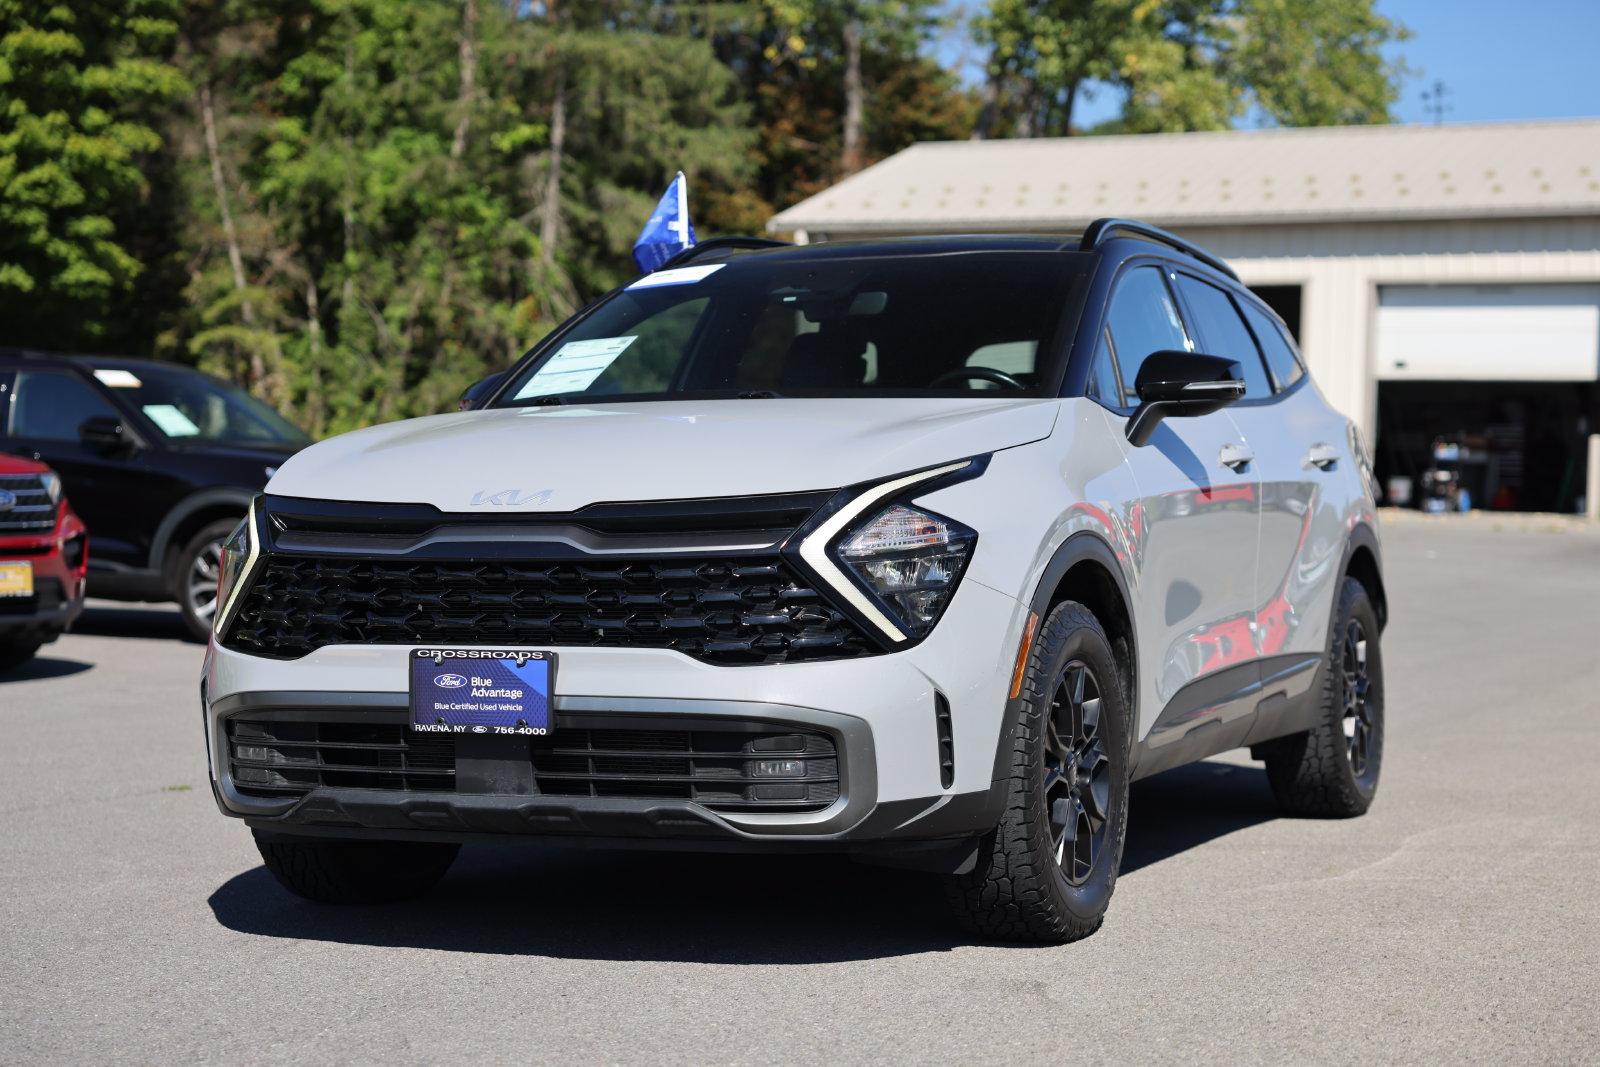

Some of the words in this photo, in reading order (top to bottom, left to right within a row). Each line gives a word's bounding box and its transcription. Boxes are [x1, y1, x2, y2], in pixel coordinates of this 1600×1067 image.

[469, 489, 554, 506] KIA
[417, 650, 543, 659] CROSSROADS
[440, 675, 461, 686] Ford
[471, 677, 492, 686] Blue
[471, 688, 523, 699] Advantage
[480, 703, 497, 711] Used
[493, 726, 547, 735] 756-4000
